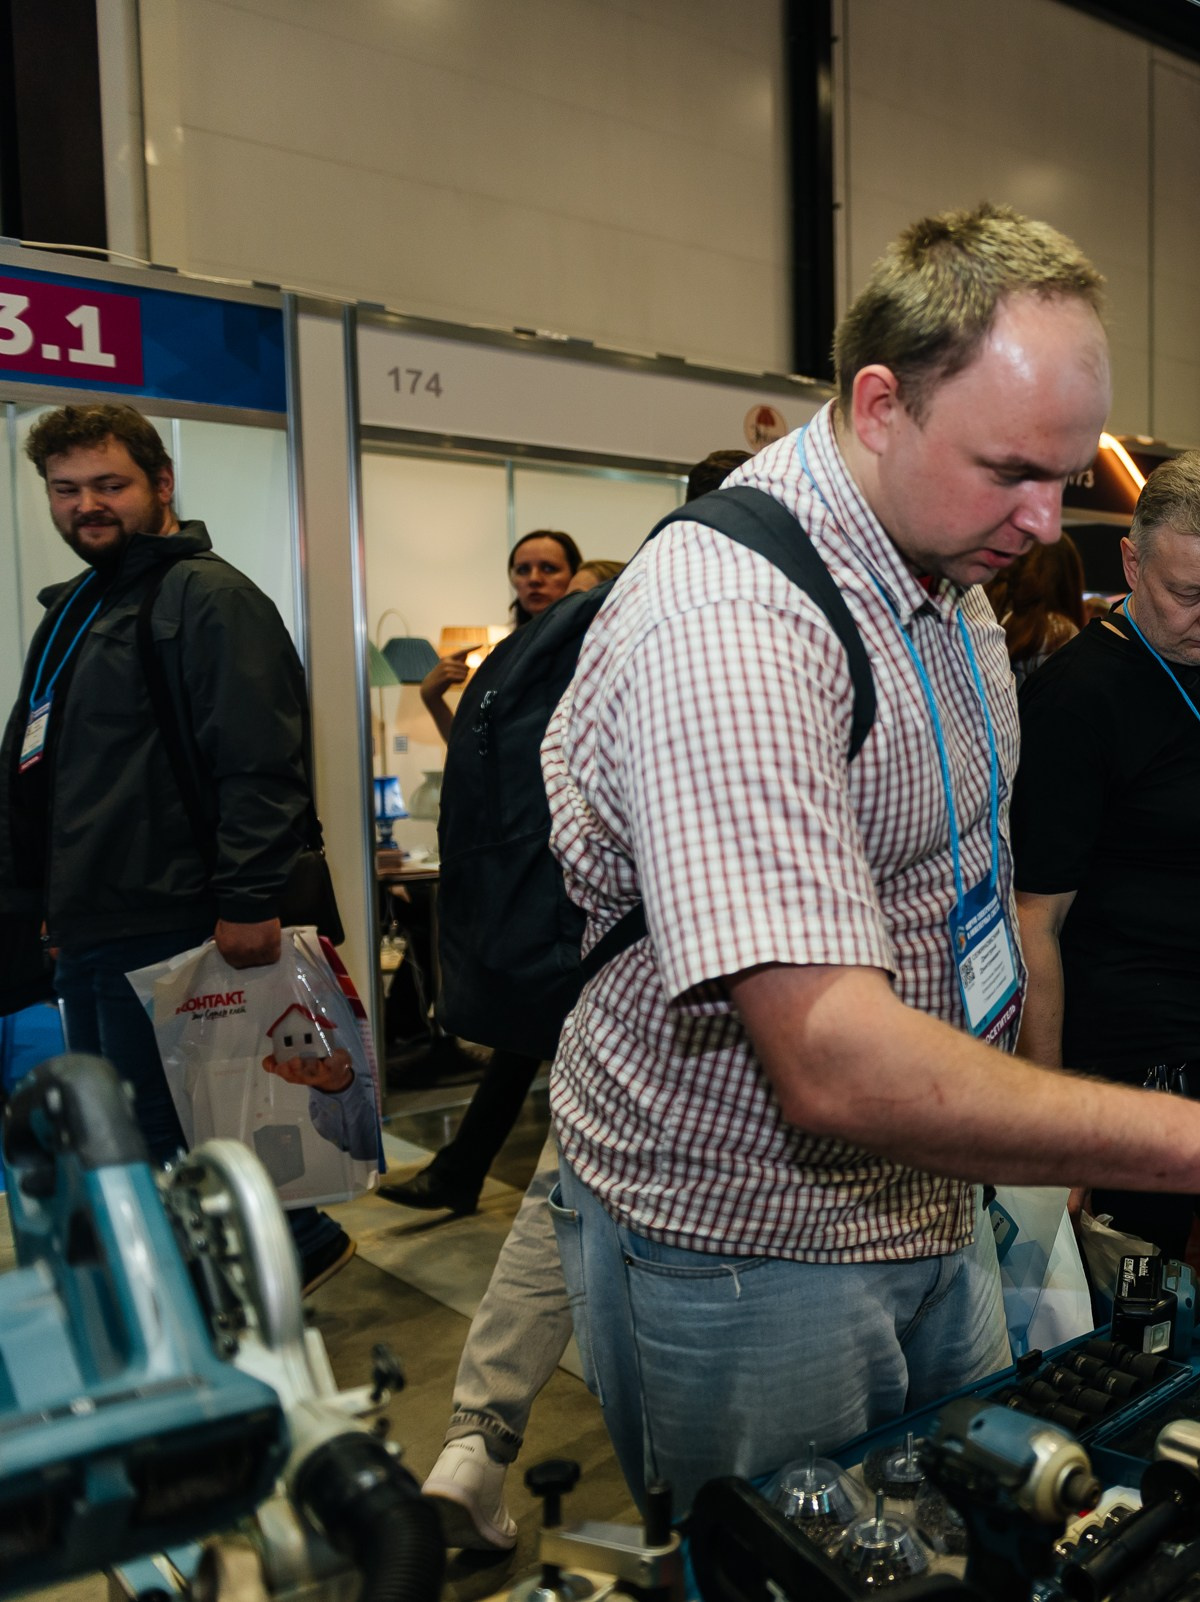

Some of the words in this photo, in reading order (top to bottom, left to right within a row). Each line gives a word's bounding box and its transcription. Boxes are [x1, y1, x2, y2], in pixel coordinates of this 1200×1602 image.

[0, 291, 117, 368] 3.1
[387, 366, 443, 399] 174
[984, 1004, 1017, 1044] ОСЕТИТЕЛЬ
